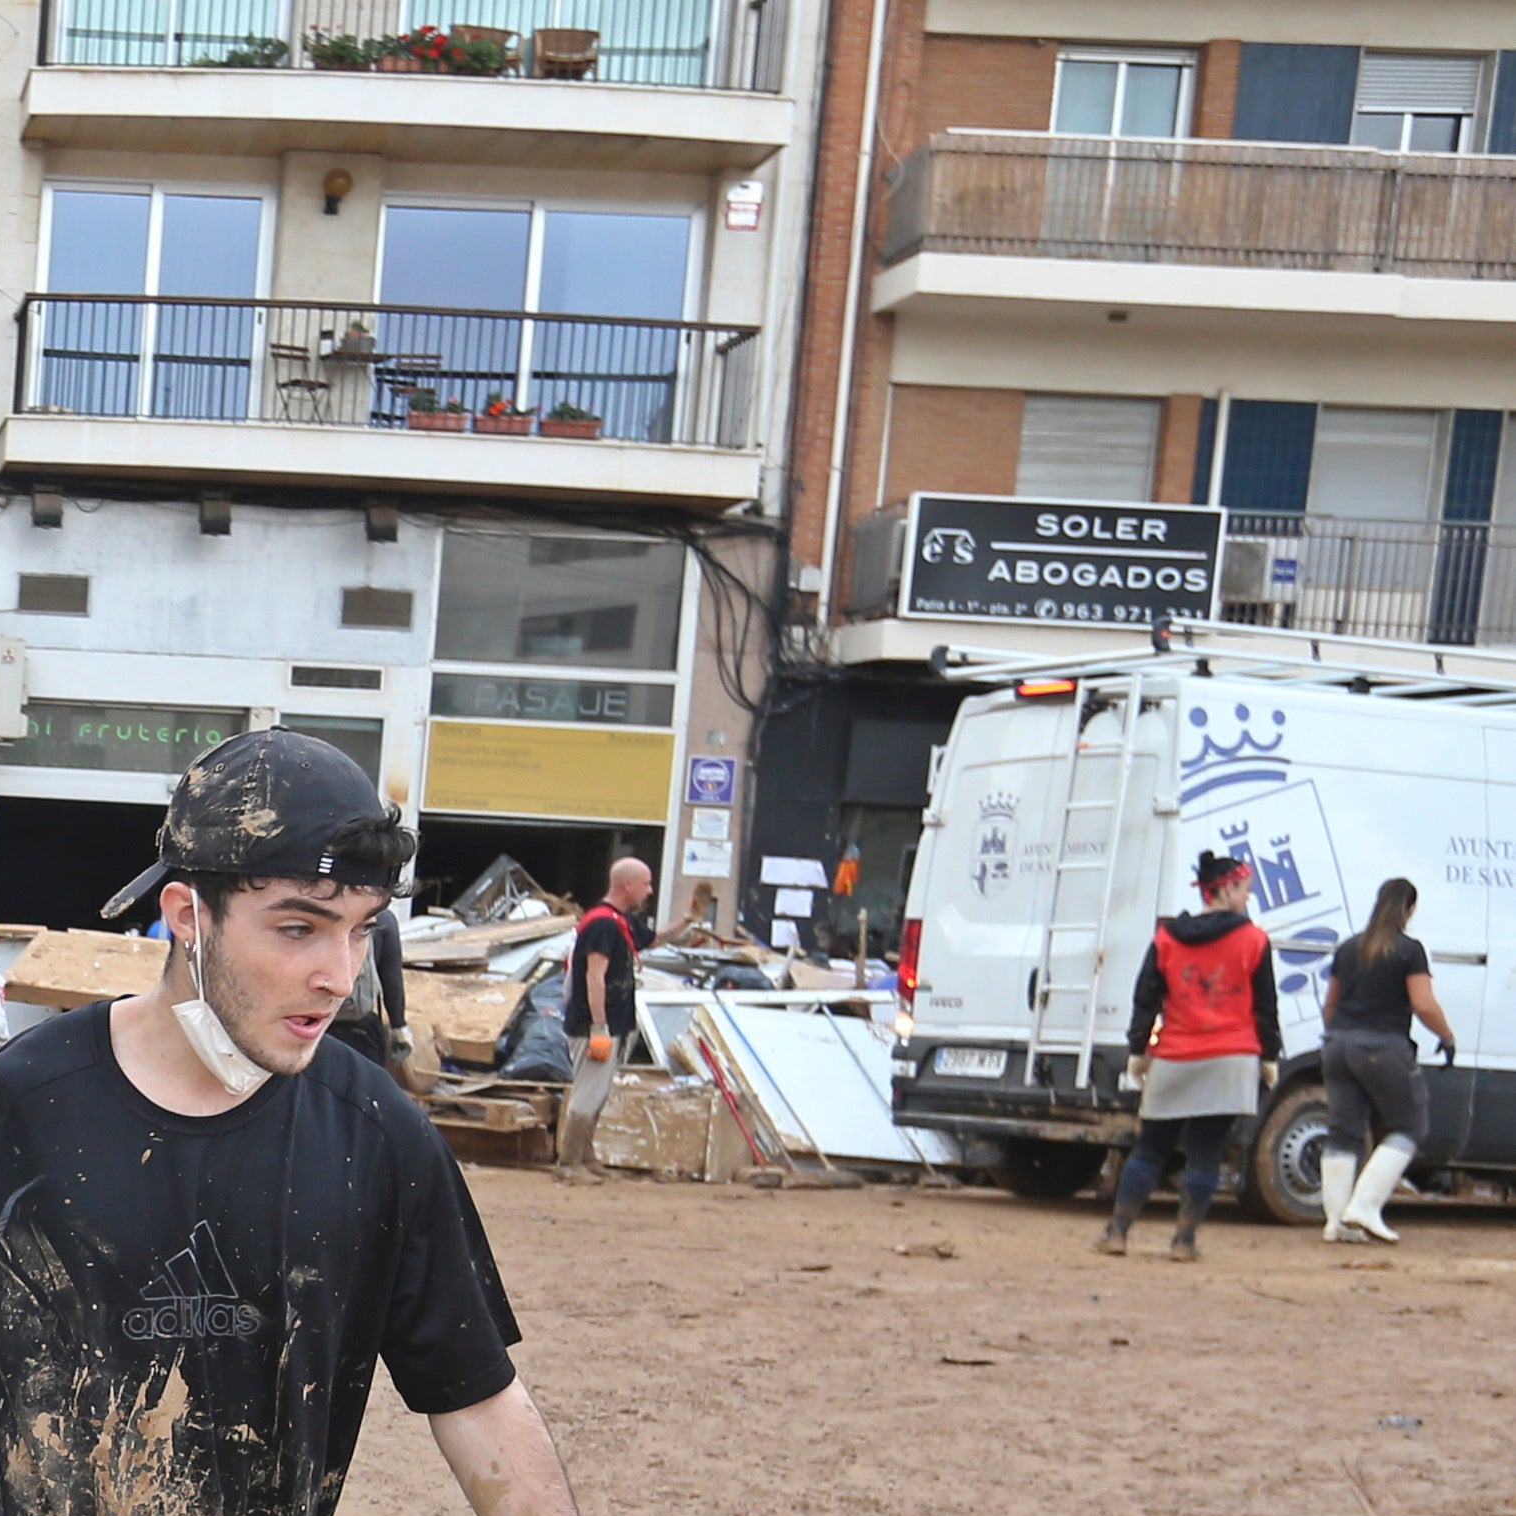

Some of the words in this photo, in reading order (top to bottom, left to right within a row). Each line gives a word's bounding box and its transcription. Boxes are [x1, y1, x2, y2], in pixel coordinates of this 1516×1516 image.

[1035, 513, 1168, 542] SOLER
[987, 559, 1208, 592] ABOGADOS
[1063, 603, 1103, 621] 963
[1113, 605, 1152, 623] 971
[474, 682, 628, 717] PASAJE
[1445, 836, 1516, 860] AYUNT
[1446, 864, 1473, 885] DE
[122, 1297, 261, 1340] adidas
